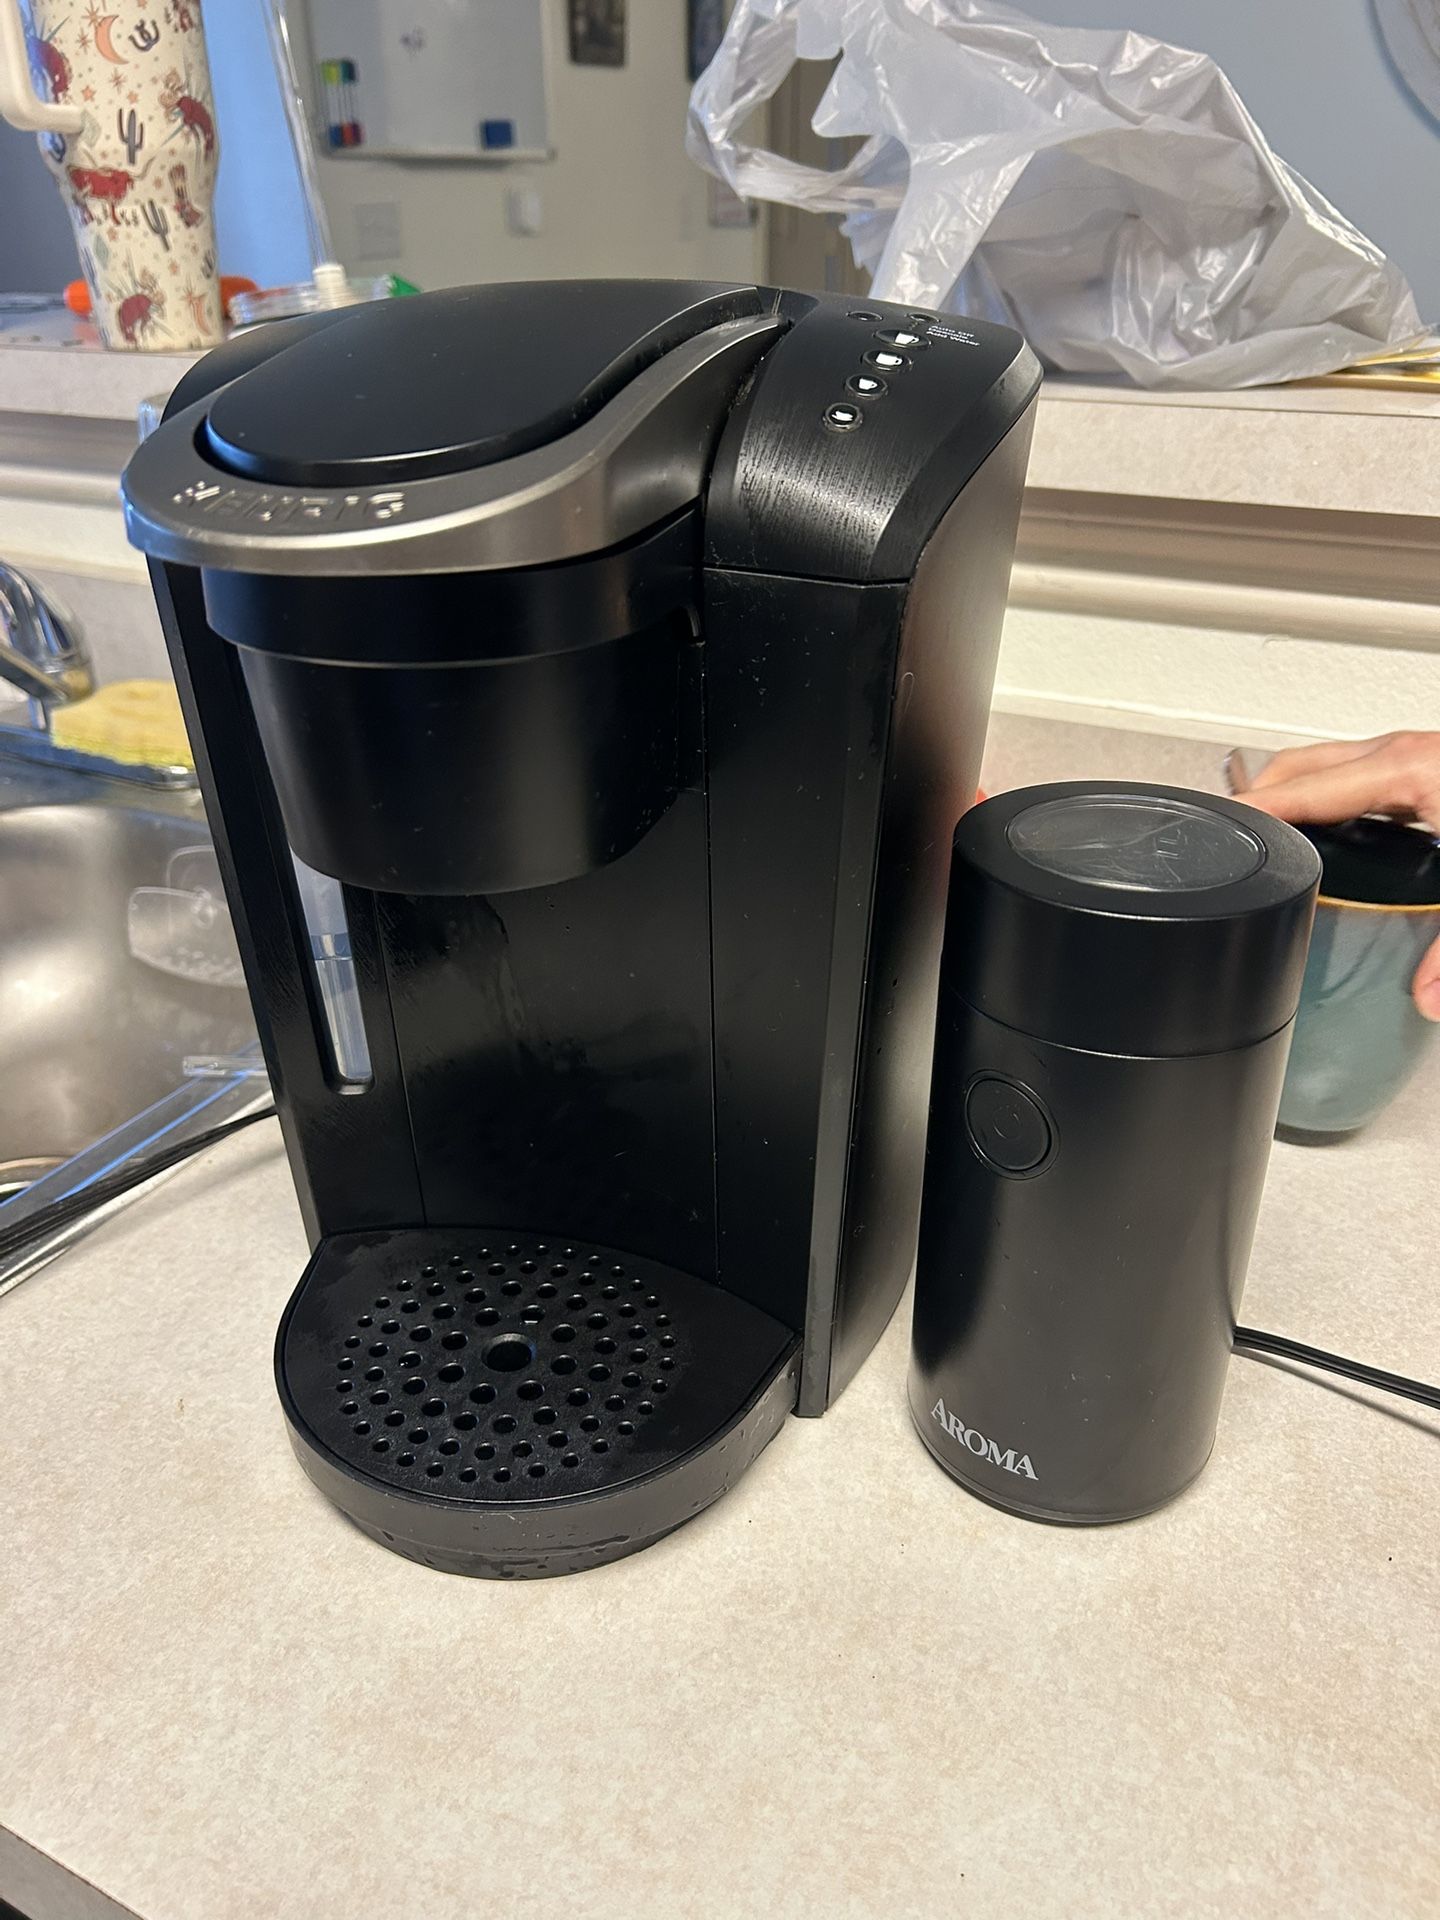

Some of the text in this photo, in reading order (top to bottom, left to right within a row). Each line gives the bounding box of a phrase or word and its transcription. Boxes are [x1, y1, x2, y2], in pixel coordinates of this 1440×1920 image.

[931, 325, 955, 333] Auto
[926, 331, 980, 346] Add Water
[931, 1398, 1039, 1480] AROMA
